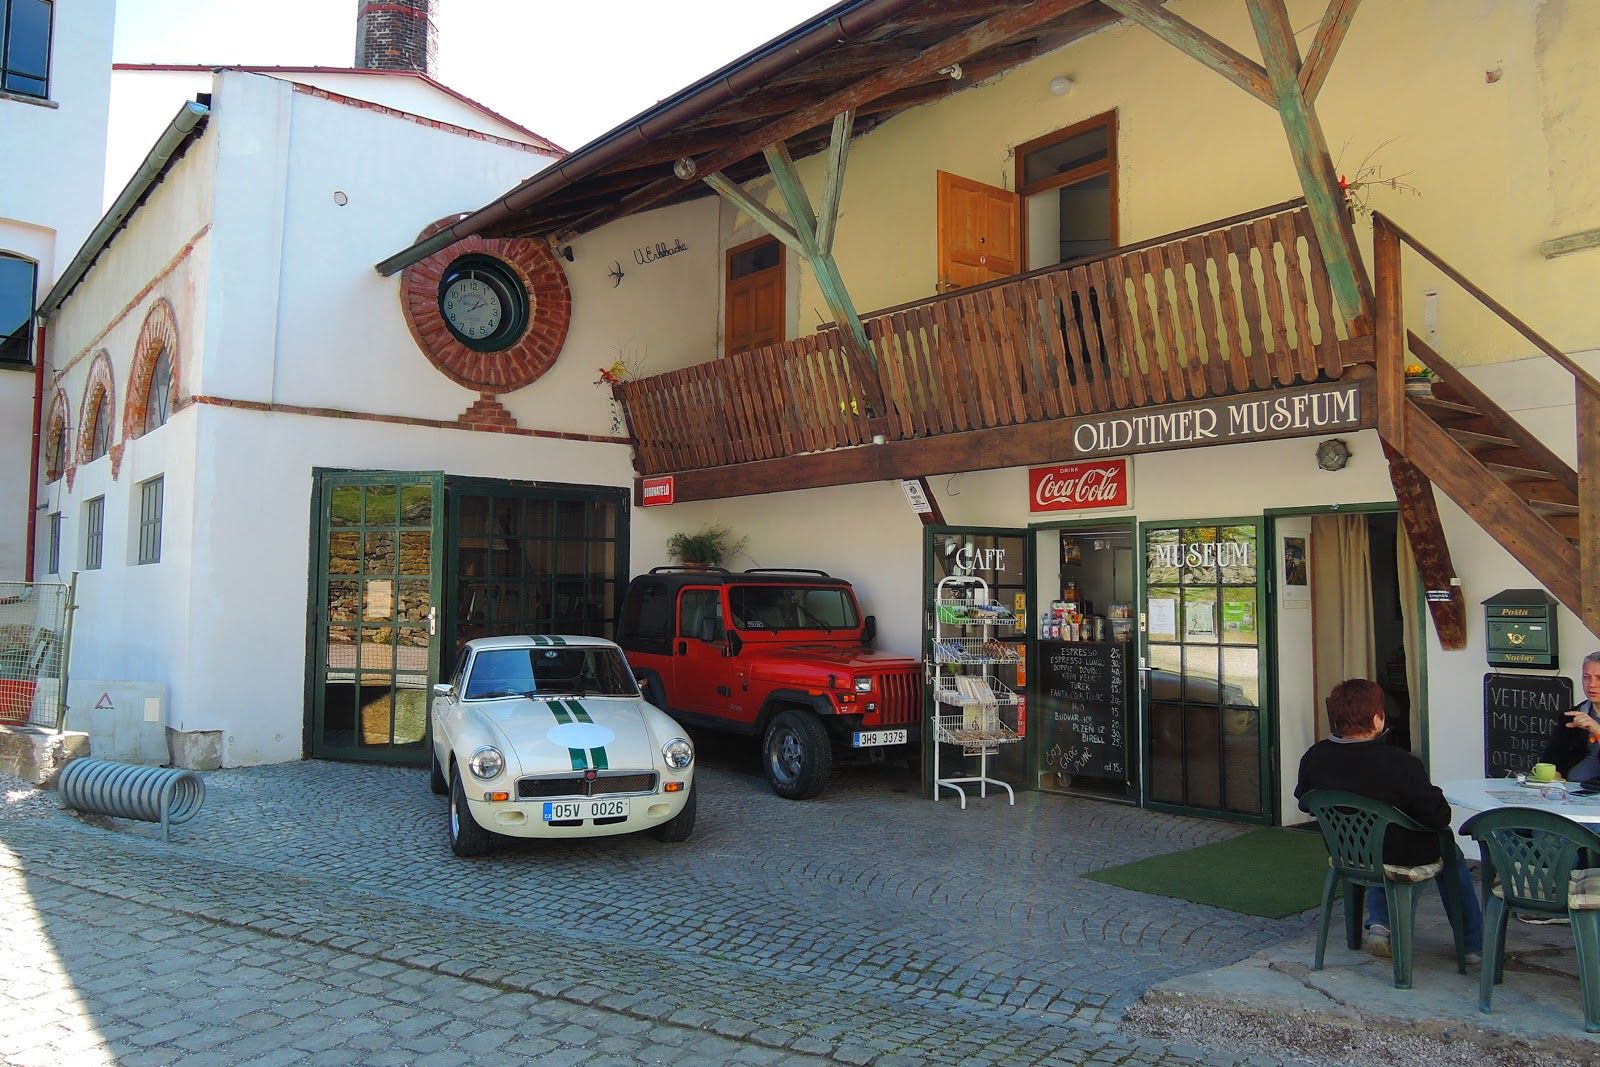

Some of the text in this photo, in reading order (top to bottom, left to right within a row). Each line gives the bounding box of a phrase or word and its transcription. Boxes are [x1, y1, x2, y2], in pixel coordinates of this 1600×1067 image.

[1073, 389, 1358, 453] OLDTIMER MUSEUM
[1060, 466, 1079, 474] DRINK
[1035, 467, 1120, 506] Coca-Cola
[955, 547, 1006, 572] CAFE
[1155, 541, 1250, 569] MUSEUM
[1061, 647, 1098, 657] ESPRESSO
[1504, 654, 1535, 663] Noviny
[1050, 656, 1083, 665] ESPRESSO
[1070, 681, 1090, 690] TUREK
[1491, 687, 1560, 711] VETERAN
[1054, 711, 1080, 723] BUDVAR
[861, 734, 877, 745] 3H9
[883, 731, 903, 744] 3379
[1082, 733, 1106, 744] BIRELL
[555, 803, 581, 818] 05V
[591, 801, 624, 816] 0026
